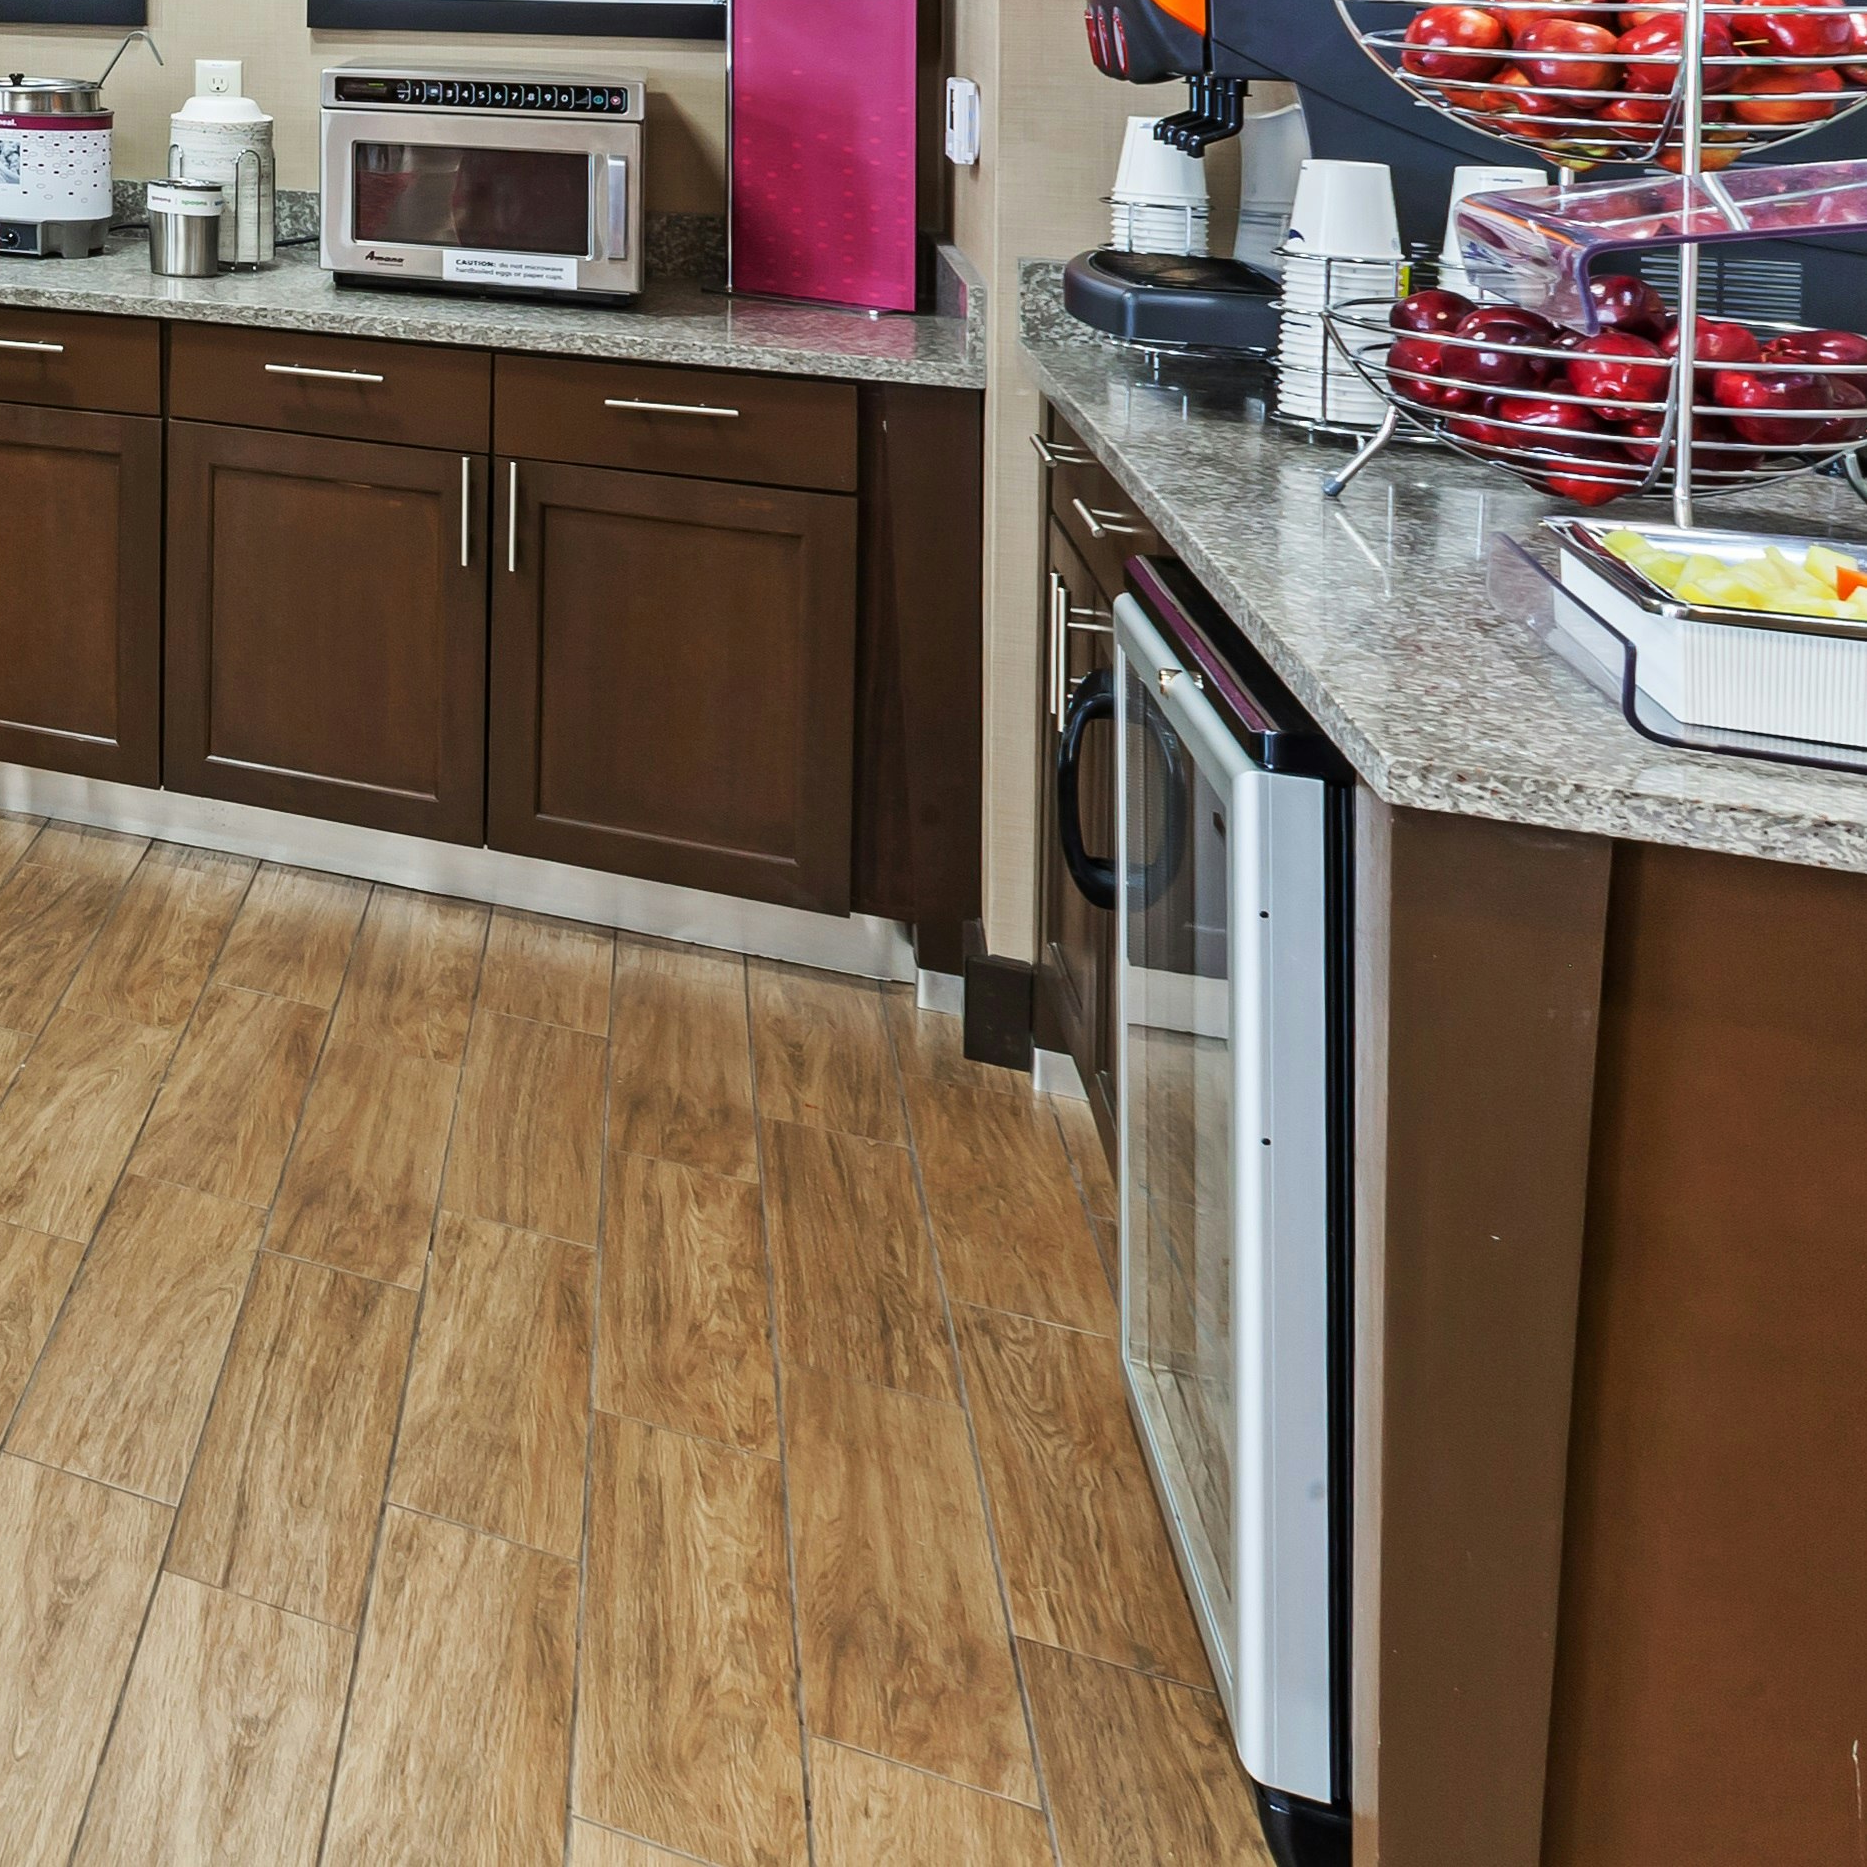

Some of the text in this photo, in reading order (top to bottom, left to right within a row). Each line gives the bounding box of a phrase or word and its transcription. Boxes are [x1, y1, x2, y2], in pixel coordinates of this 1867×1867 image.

[446, 89, 453, 98] 3
[462, 90, 469, 98] 4
[478, 90, 485, 99] 5
[494, 92, 502, 100] 6
[511, 92, 518, 100] 7
[527, 93, 535, 101] 8
[544, 93, 552, 102] 9
[560, 94, 569, 102] 0
[365, 250, 405, 263] Amana
[455, 259, 496, 268] CAUTION:
